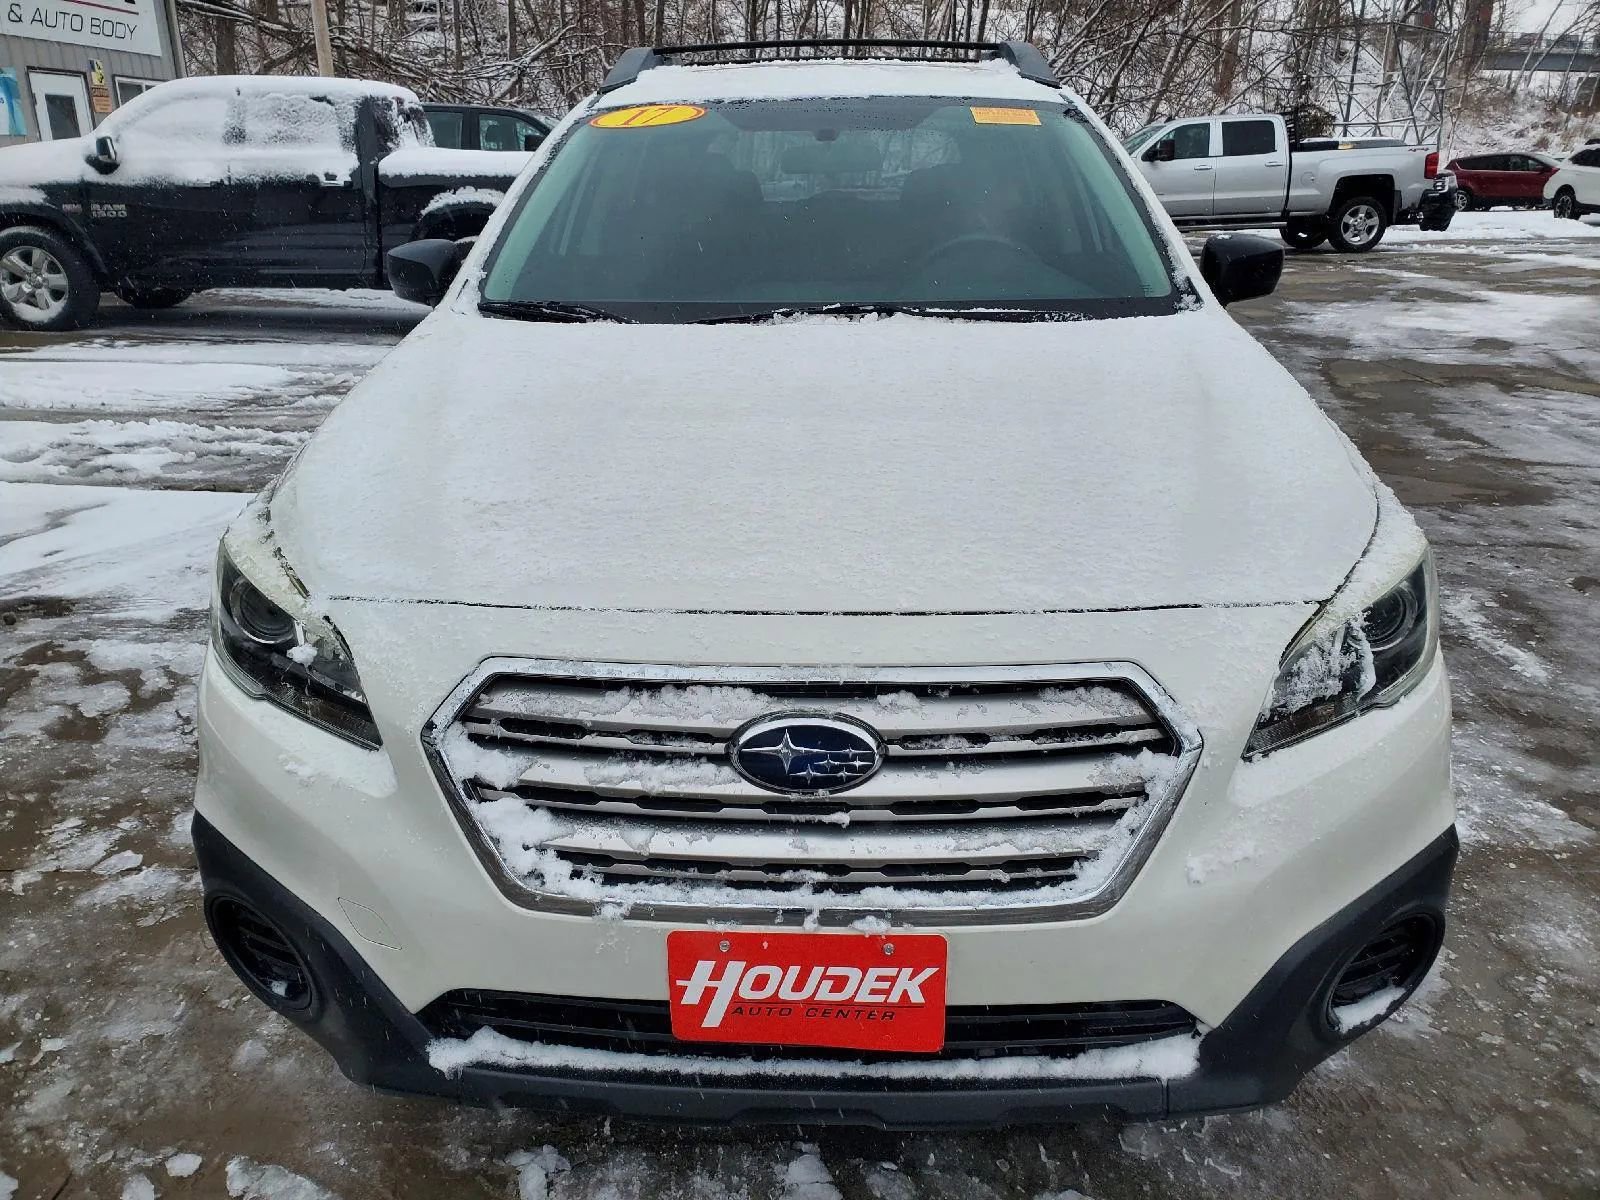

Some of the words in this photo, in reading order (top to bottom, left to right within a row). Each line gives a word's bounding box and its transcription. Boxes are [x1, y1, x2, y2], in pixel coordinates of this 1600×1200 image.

[7, 3, 24, 24] &
[30, 7, 84, 33] AUTO
[90, 17, 138, 41] BODY
[615, 106, 678, 126] 17
[90, 203, 126, 211] RAM
[731, 1006, 793, 1018] AUTO
[805, 1007, 896, 1021] CENTER
